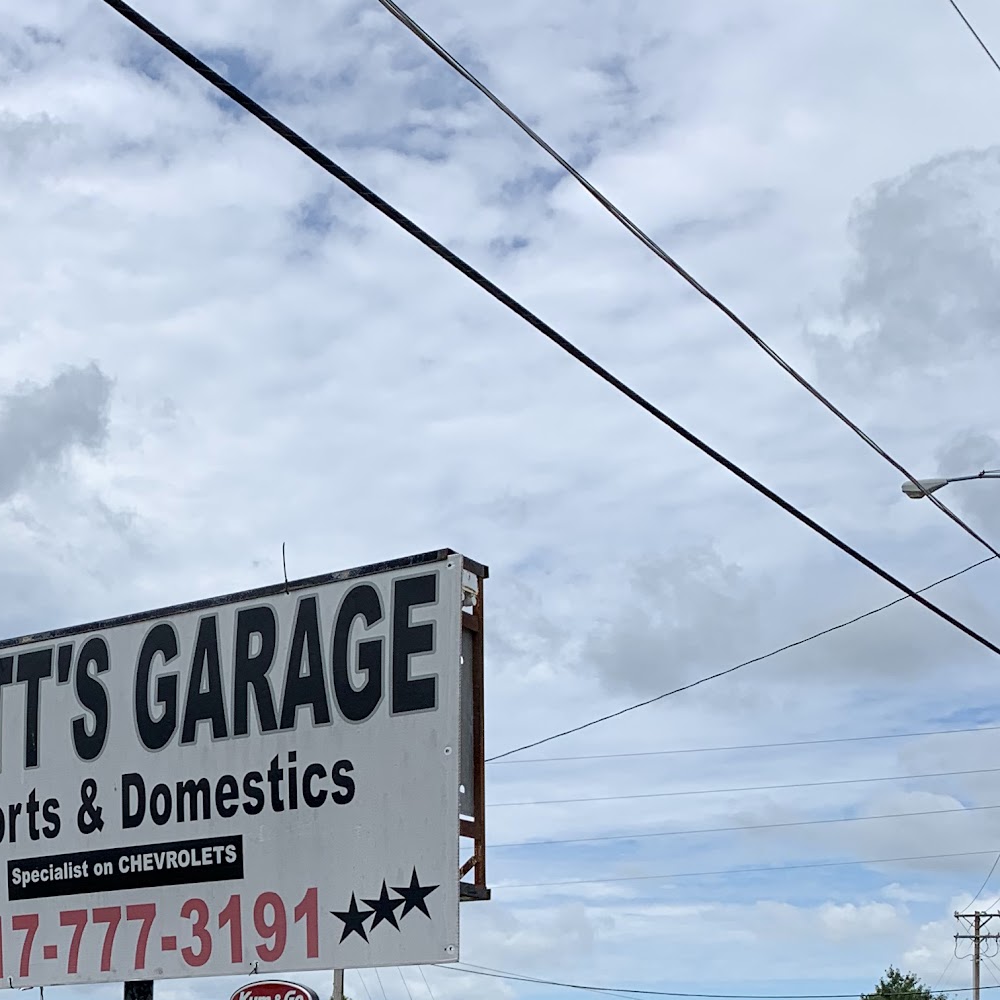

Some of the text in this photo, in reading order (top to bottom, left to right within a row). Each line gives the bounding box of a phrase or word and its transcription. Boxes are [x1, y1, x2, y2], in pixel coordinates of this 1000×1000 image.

[134, 571, 438, 751] GARAGE
[78, 778, 104, 835] &
[122, 752, 356, 829] Domestics
[11, 844, 238, 888] Specialist on CHEVROLETS
